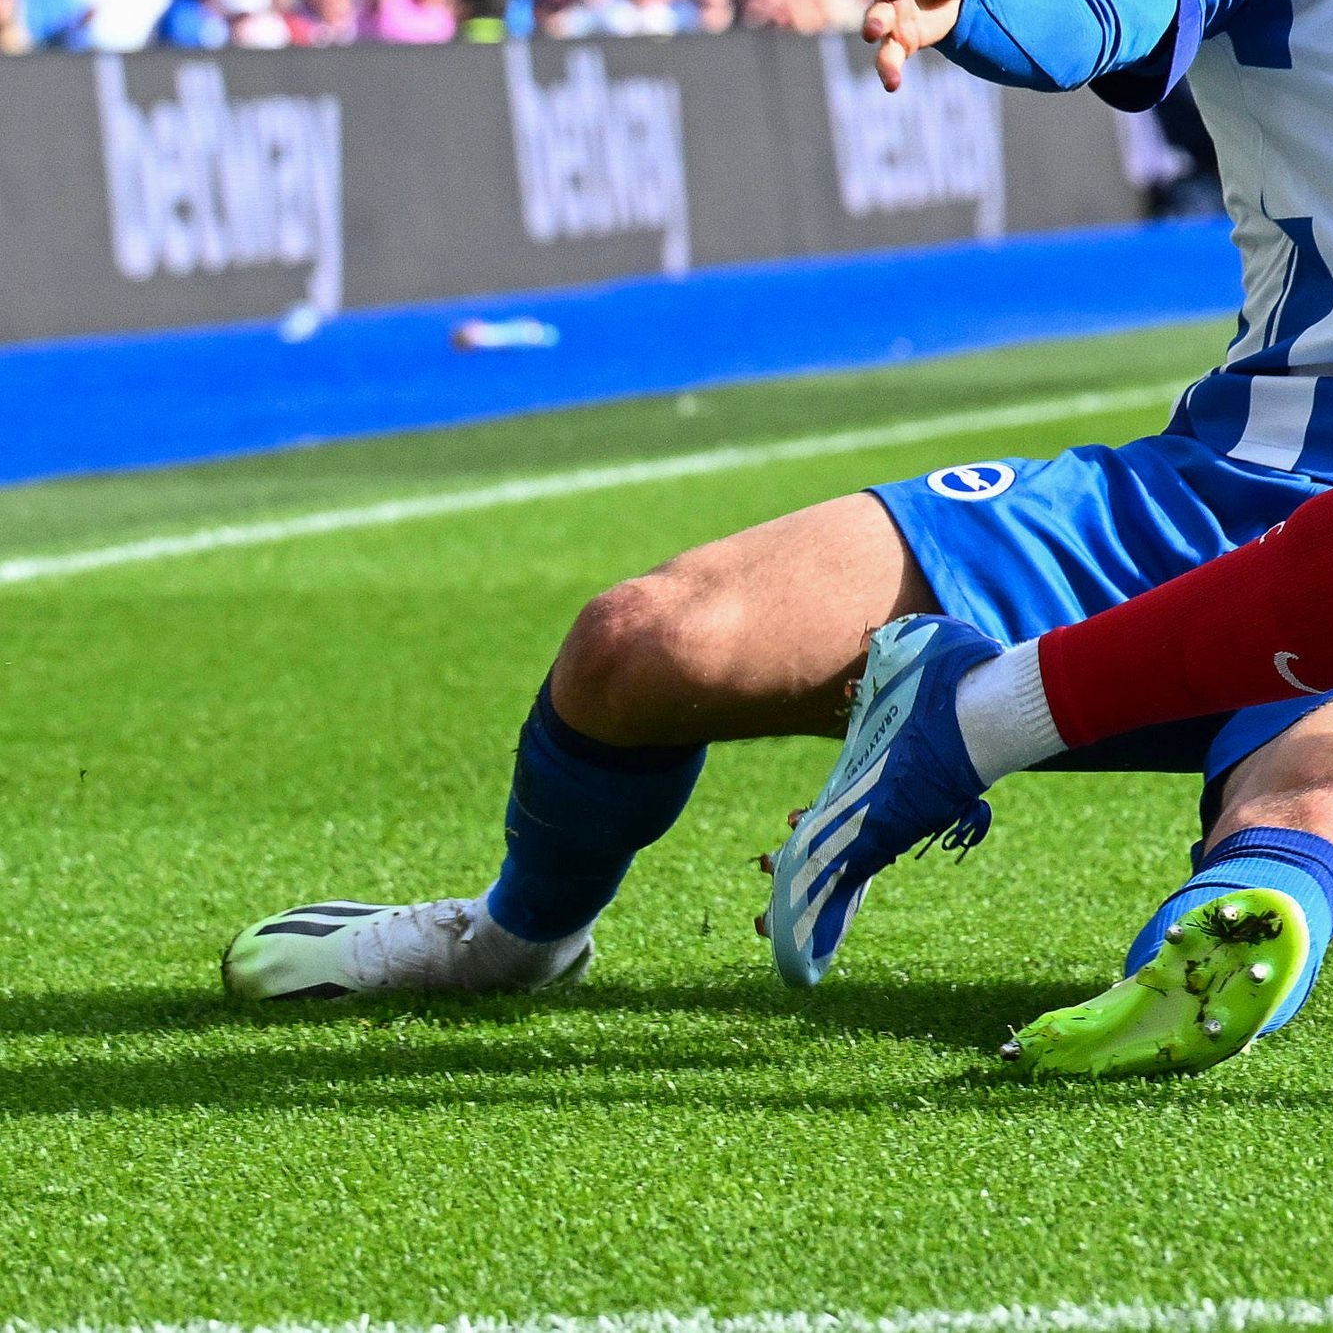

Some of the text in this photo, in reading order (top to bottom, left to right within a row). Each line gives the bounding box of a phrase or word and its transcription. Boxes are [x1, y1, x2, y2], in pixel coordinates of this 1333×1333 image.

[95, 51, 343, 317] betway
[504, 39, 692, 283] betway
[820, 31, 1007, 241] betway
